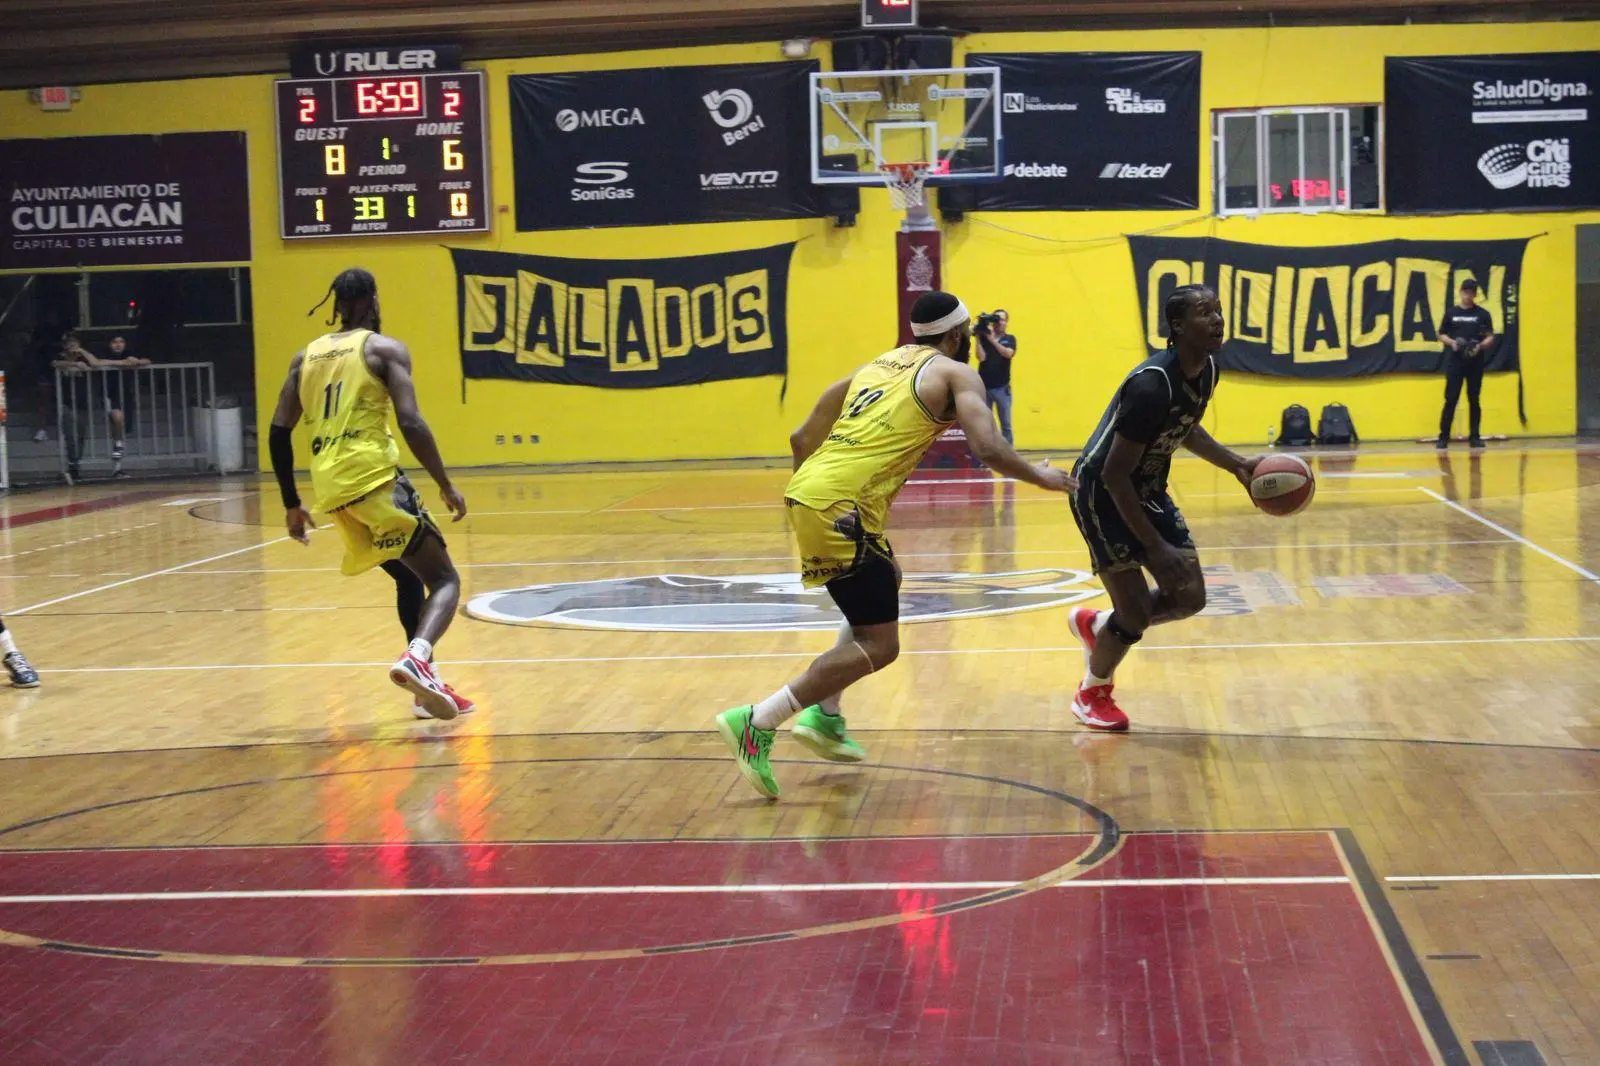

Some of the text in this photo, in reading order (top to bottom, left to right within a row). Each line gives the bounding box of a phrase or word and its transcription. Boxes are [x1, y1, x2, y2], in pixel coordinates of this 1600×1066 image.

[344, 49, 436, 72] RULER
[356, 81, 420, 114] 6:59
[1472, 78, 1588, 102] SaludDigna
[299, 99, 317, 123] 2
[443, 92, 460, 117] 2
[295, 127, 348, 141] GUEST
[416, 122, 464, 136] HOME
[722, 115, 766, 147] Berel
[324, 144, 347, 175] 8
[442, 140, 464, 171] 6
[359, 164, 406, 177] PERIOD
[700, 170, 779, 187] VENTO
[1014, 162, 1068, 178] debate
[1118, 163, 1172, 178] telcel
[12, 183, 180, 202] AYUNTAMIENTO DE
[571, 186, 635, 202] SoniGas
[11, 199, 183, 231] CULIACÁN
[353, 197, 385, 221] 33
[450, 193, 469, 217] 0
[13, 236, 184, 250] CAPITAL DE BIENESTAR
[463, 268, 773, 372] JALADOS
[324, 381, 343, 420] 11
